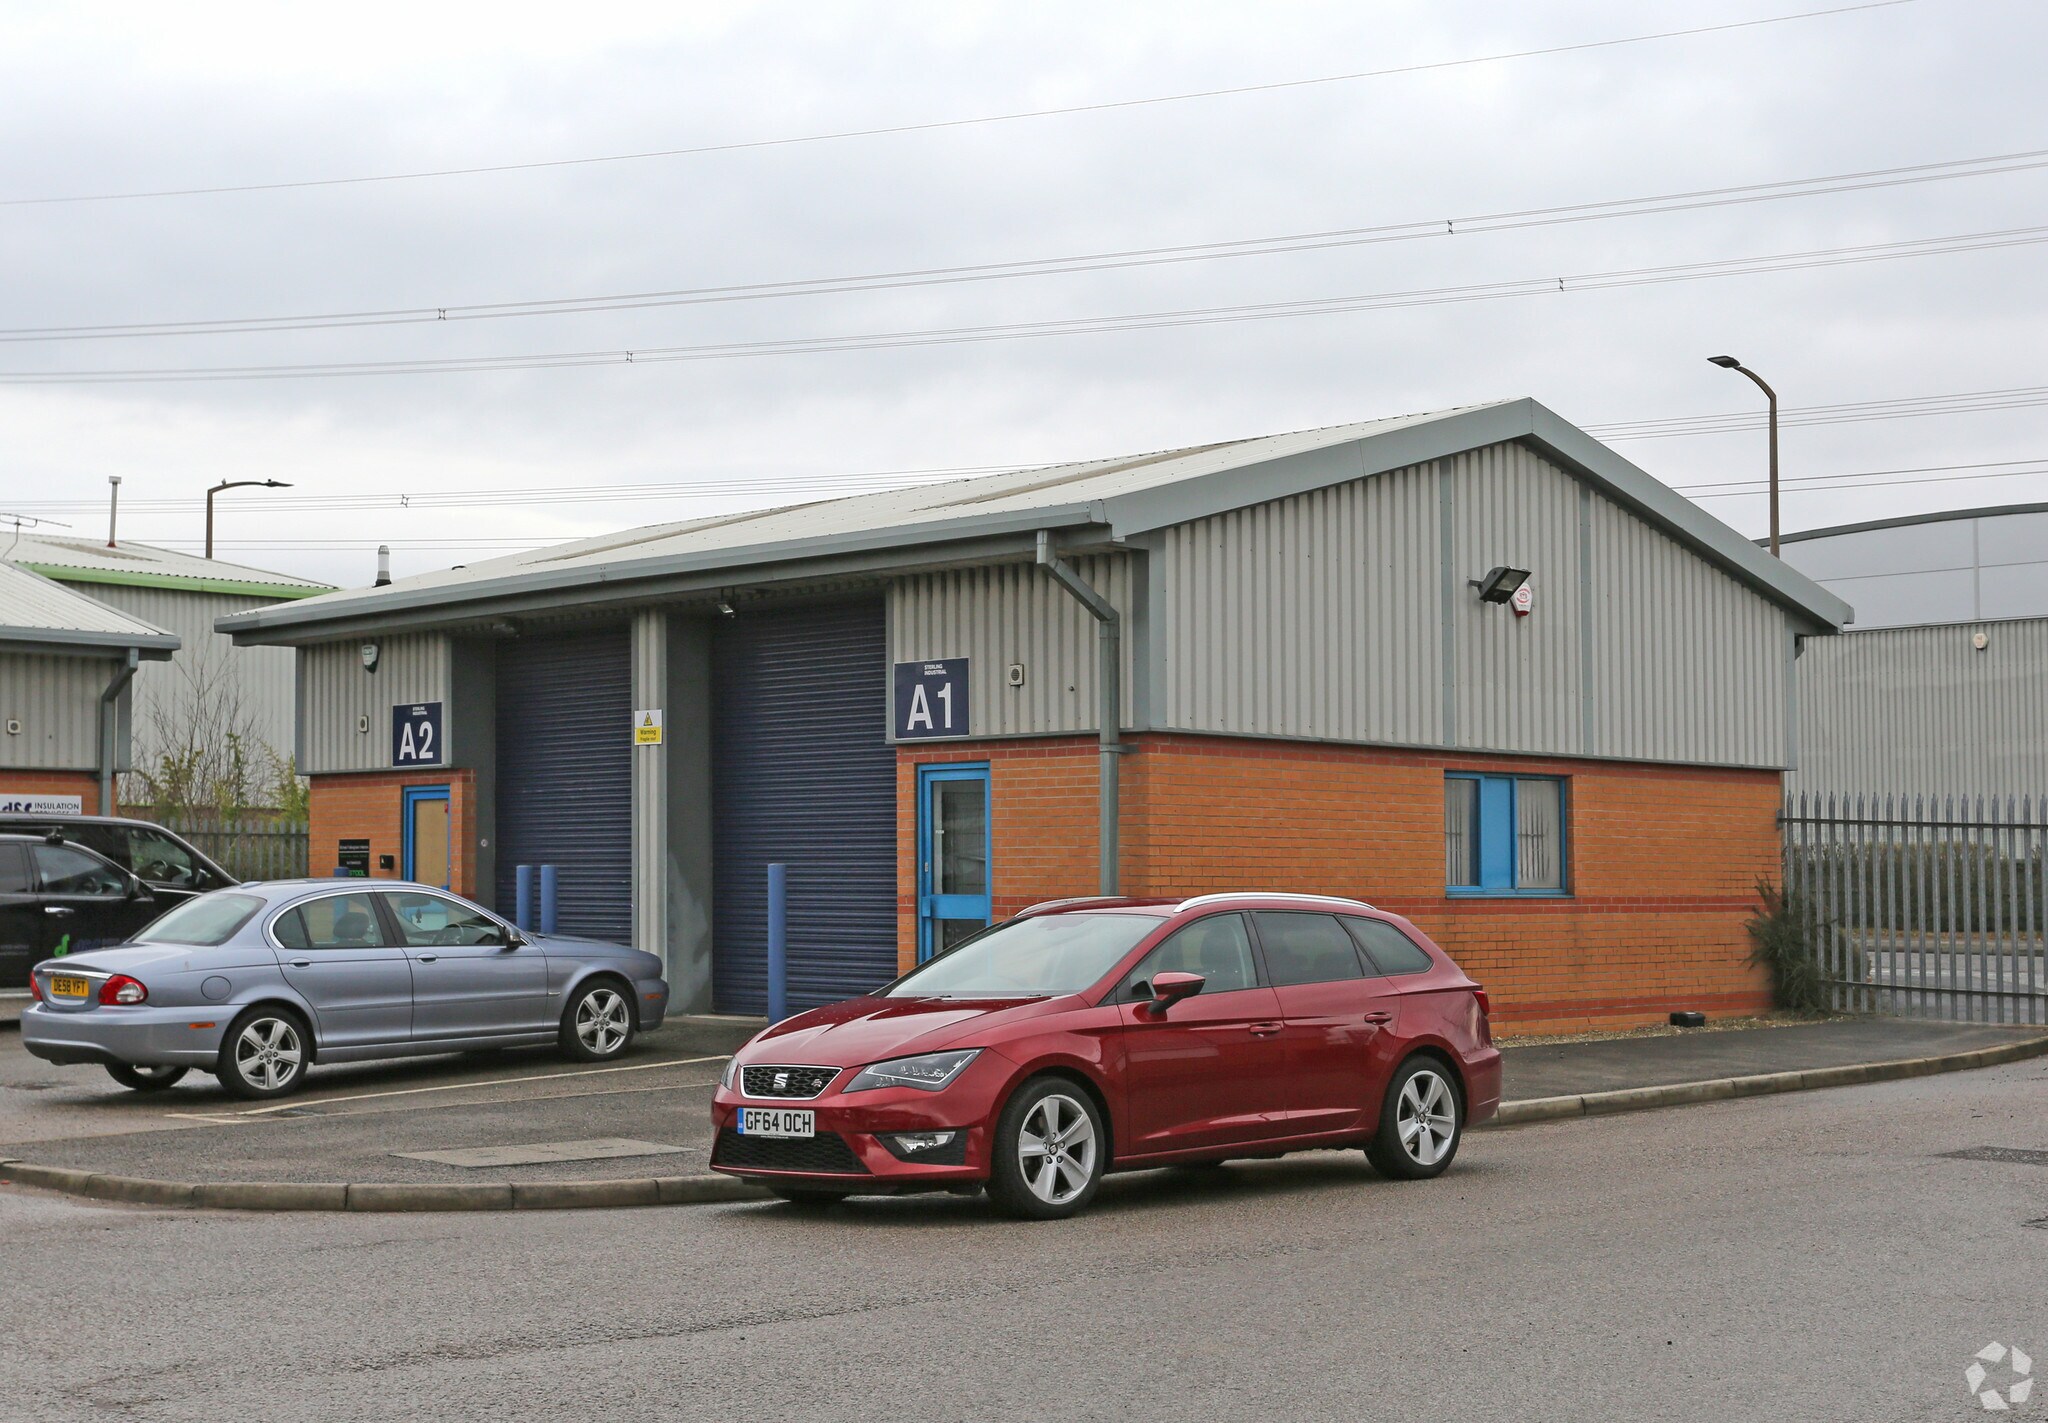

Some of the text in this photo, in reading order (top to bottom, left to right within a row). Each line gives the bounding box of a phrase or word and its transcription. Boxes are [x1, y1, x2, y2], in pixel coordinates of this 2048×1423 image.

[907, 682, 952, 731] A1
[399, 721, 433, 760] A2
[34, 802, 80, 810] INSULATION
[53, 978, 86, 994] DE58 YFT
[745, 1111, 812, 1134] GF64 OCH
